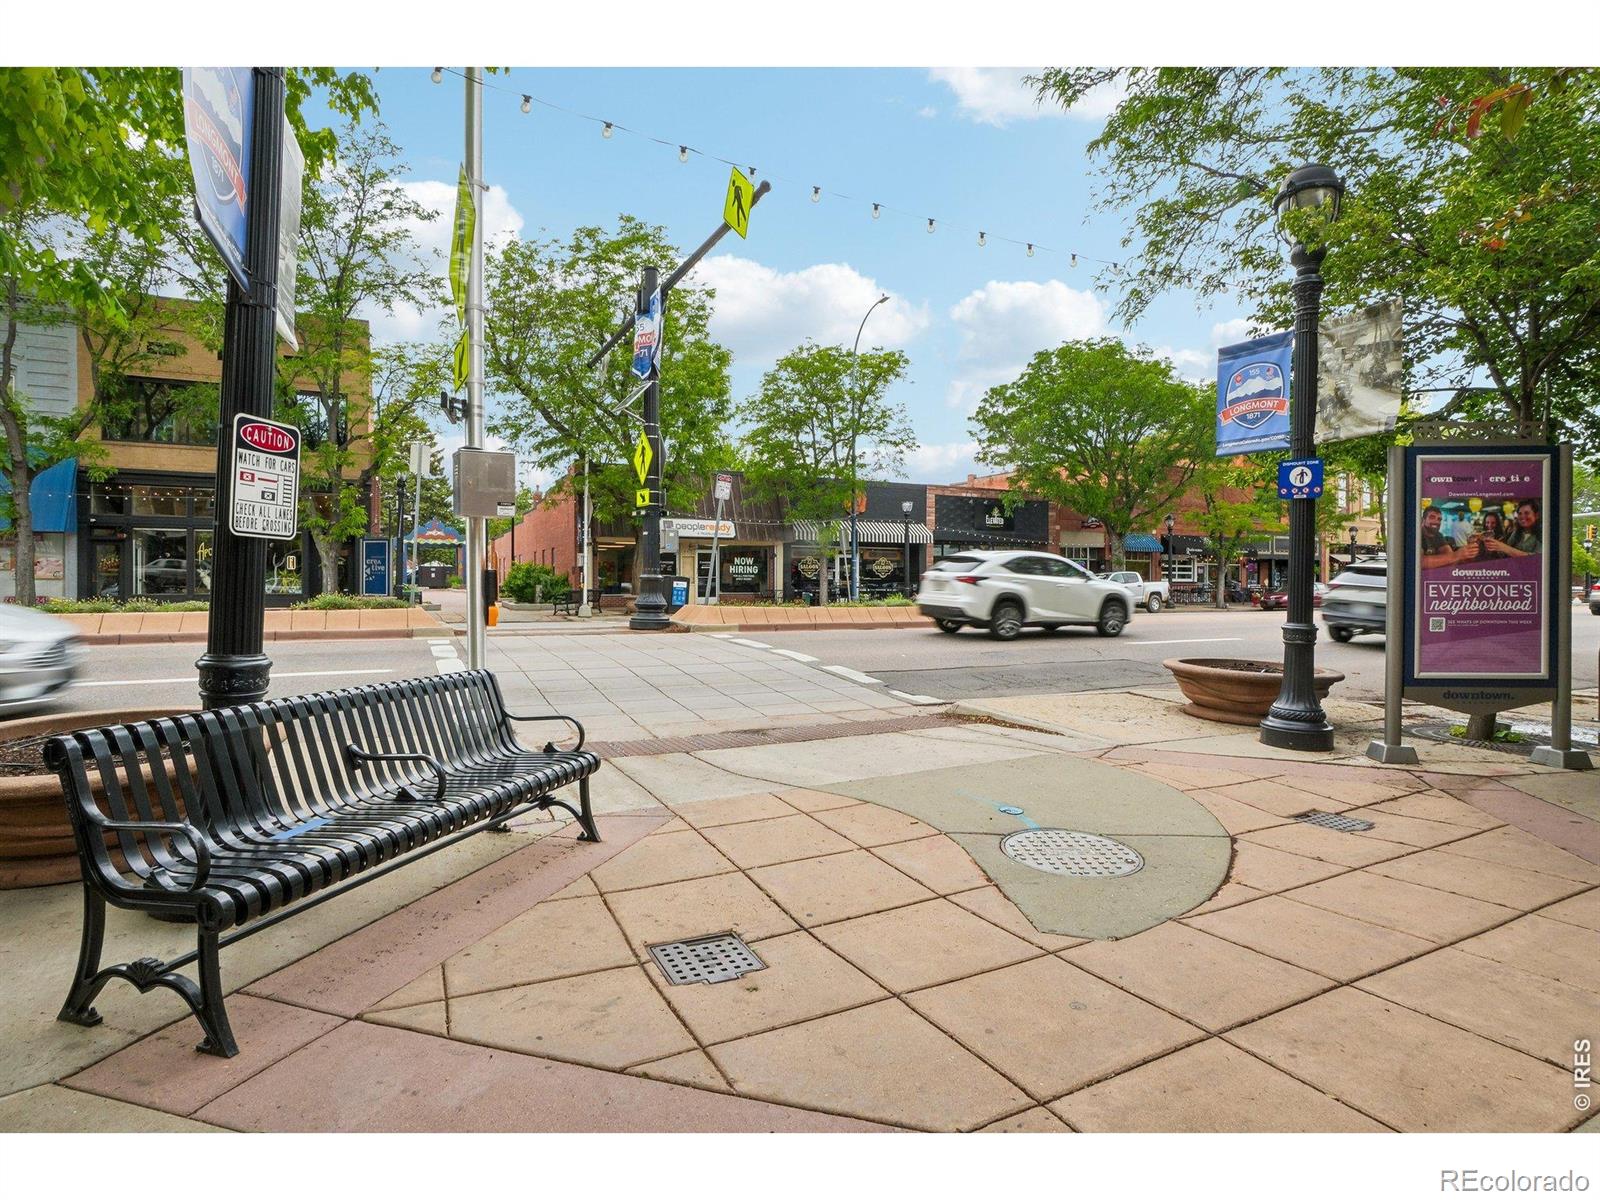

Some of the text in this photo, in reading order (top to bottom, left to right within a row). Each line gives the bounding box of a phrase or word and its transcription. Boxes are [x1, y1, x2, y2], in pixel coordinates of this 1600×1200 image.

[195, 113, 239, 184] LONGMONT
[1249, 367, 1260, 376] 155
[1229, 400, 1280, 416] LONGMONT
[1246, 412, 1260, 420] 1871
[246, 426, 289, 450] CAUTION
[238, 451, 295, 474] WATCH FOR CARS
[235, 502, 293, 521] CHECK ALL LANES
[235, 516, 292, 533] BEFORE CROSSING
[734, 557, 754, 565] NOW
[729, 565, 759, 574] HIRING
[1451, 568, 1510, 577] downtown.
[1428, 584, 1533, 598] EVERYONE'S
[1429, 597, 1532, 615] neighborhood
[1442, 690, 1515, 700] downtown.
